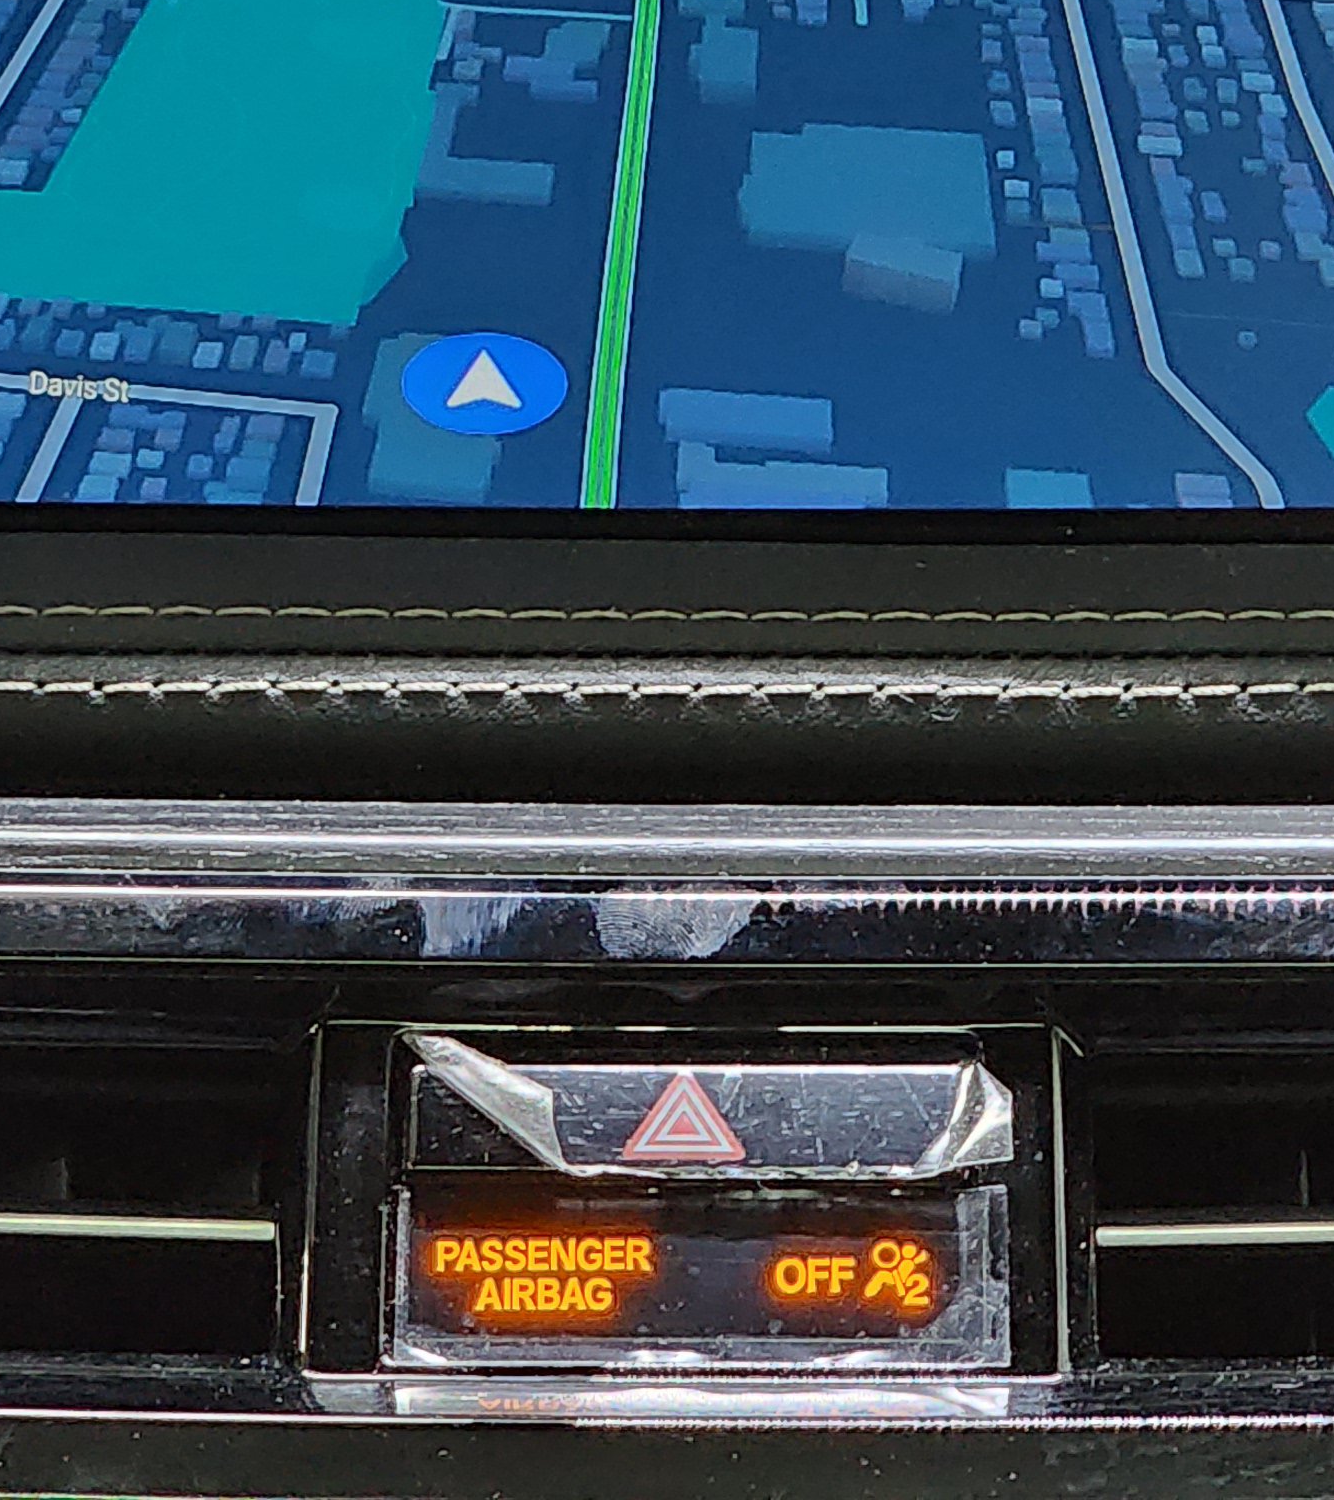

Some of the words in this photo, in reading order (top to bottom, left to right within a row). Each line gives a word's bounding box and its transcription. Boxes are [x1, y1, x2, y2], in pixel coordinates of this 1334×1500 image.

[28, 369, 98, 400] Davis
[102, 377, 130, 404] St
[435, 1238, 653, 1274] PASSENGER
[474, 1276, 614, 1312] AIRBAG
[776, 1257, 856, 1295] OFF
